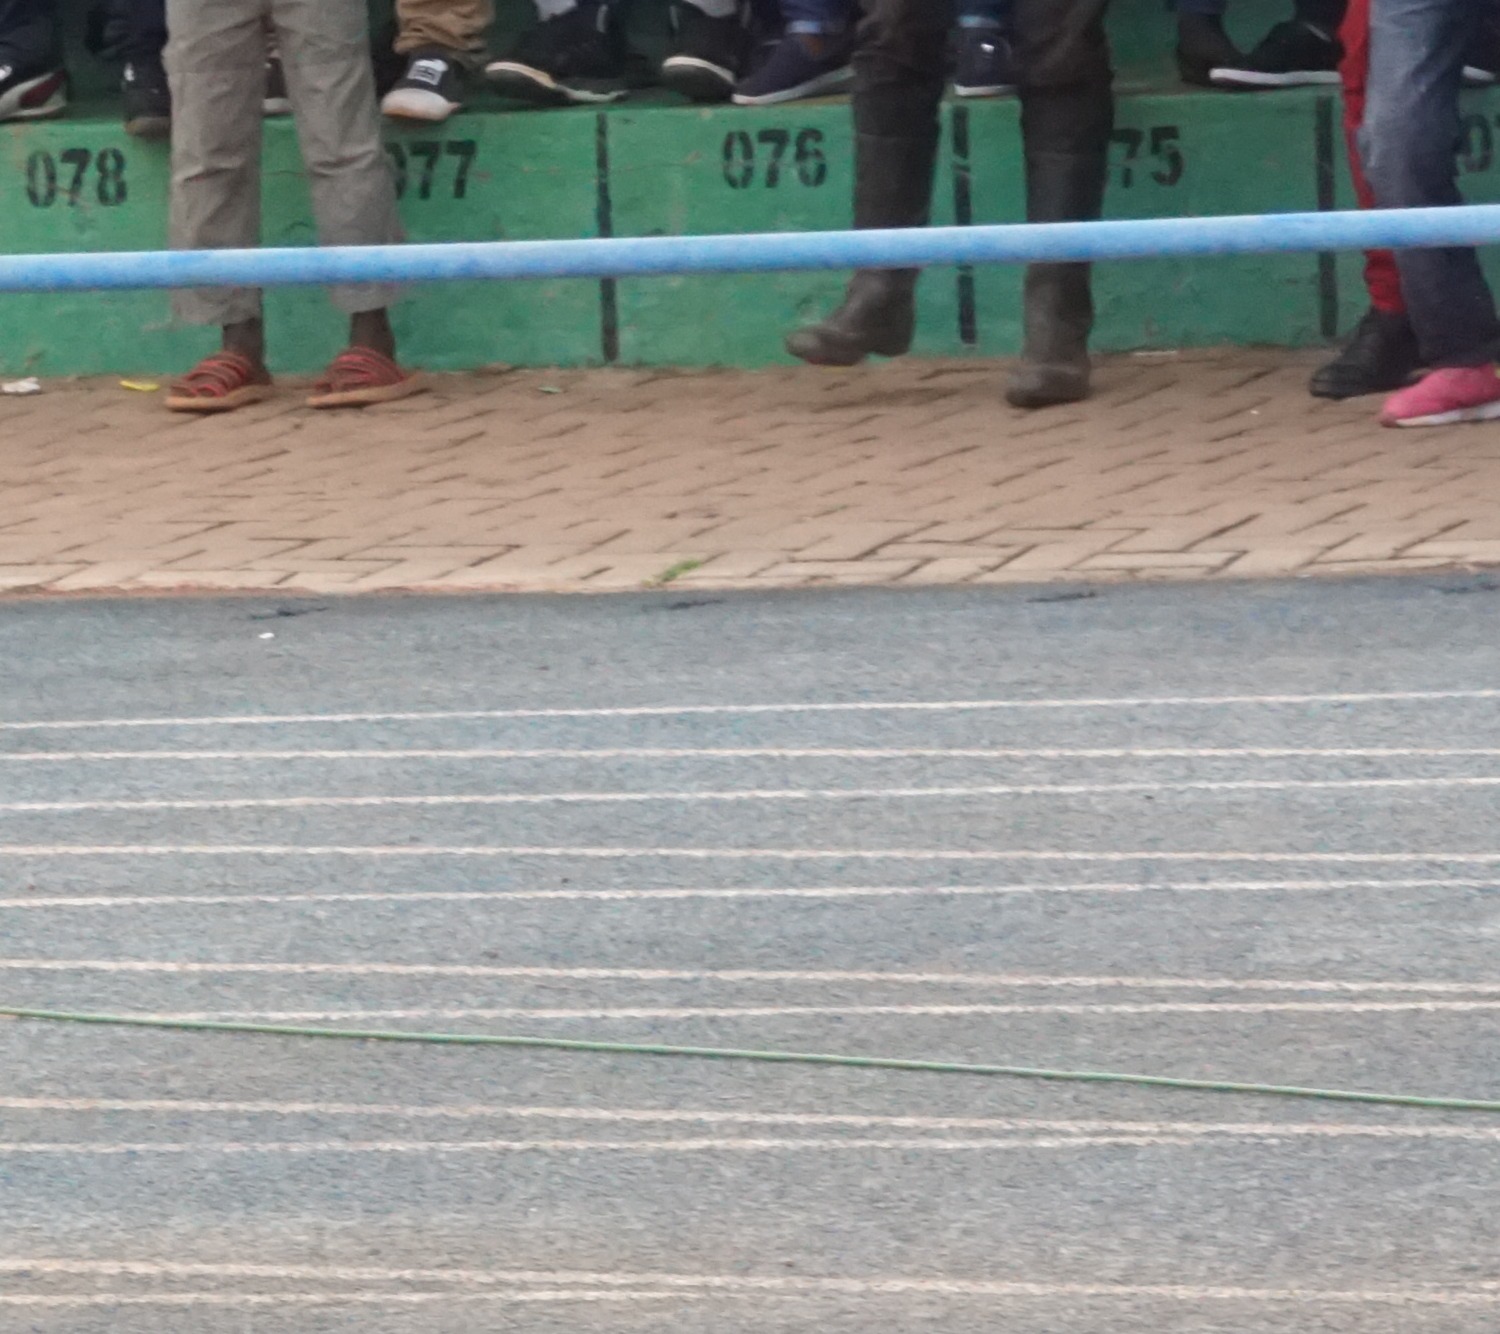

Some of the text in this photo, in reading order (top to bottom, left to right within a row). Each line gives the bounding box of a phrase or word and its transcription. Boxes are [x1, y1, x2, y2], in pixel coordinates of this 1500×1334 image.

[27, 147, 127, 208] 078
[722, 128, 827, 190] 076
[1108, 125, 1185, 188] 75
